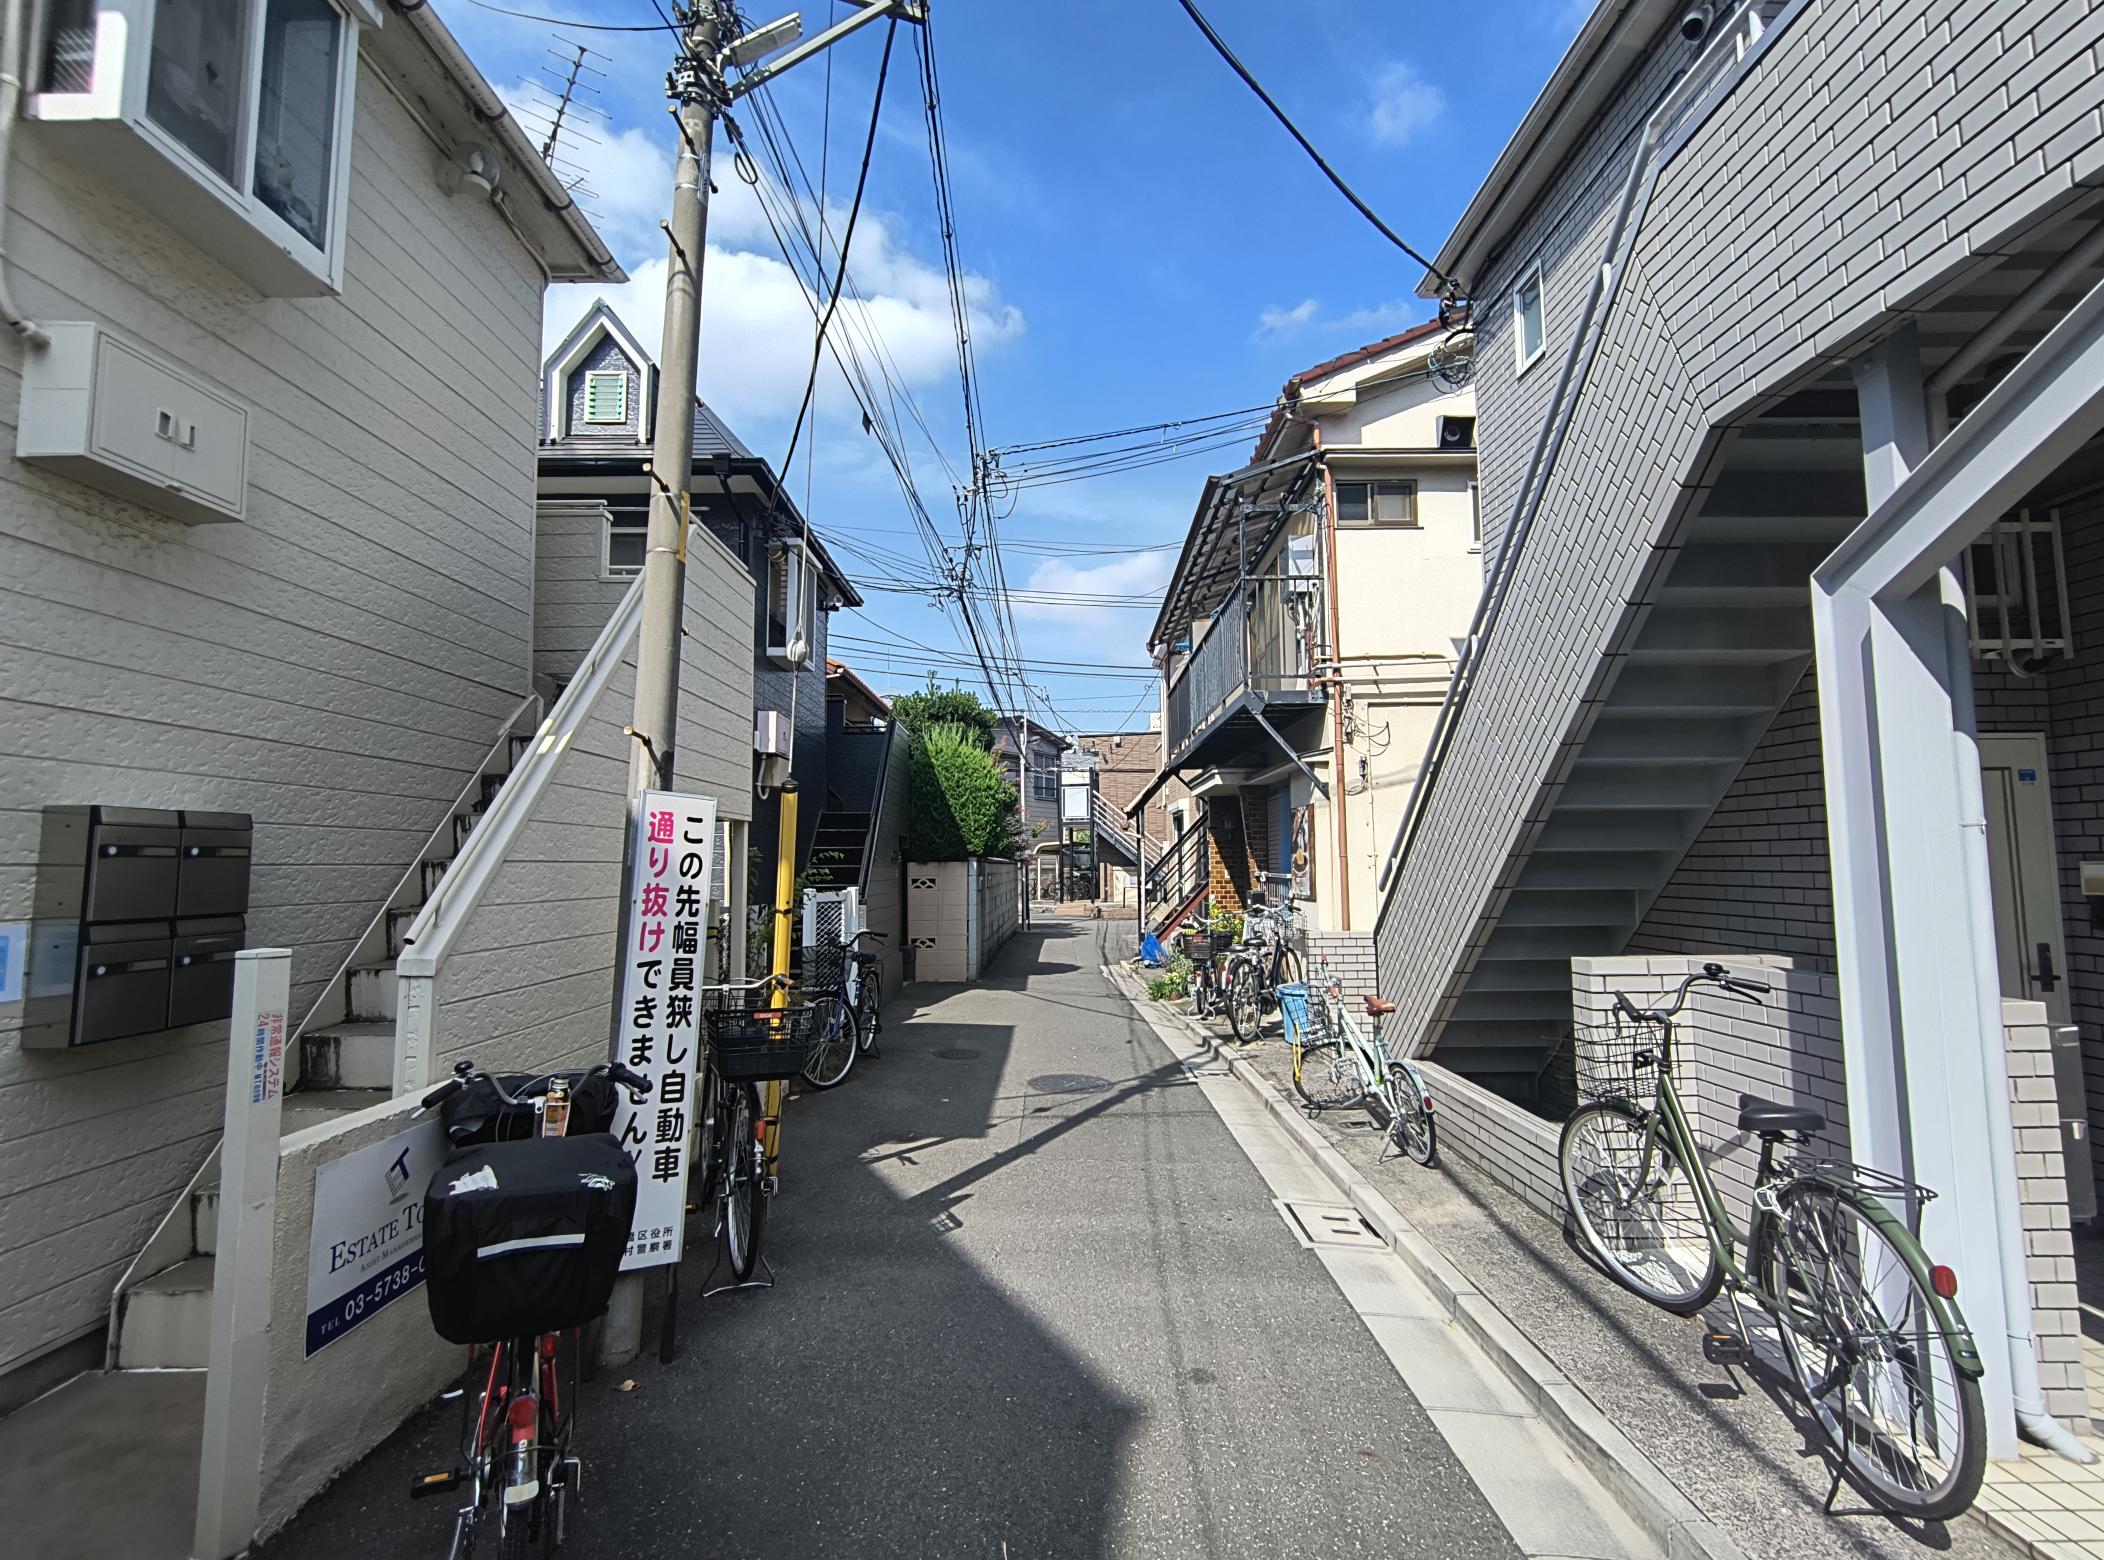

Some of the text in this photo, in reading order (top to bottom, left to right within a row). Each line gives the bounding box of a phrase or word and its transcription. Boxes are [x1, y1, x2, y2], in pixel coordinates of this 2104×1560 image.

[652, 816, 703, 1183] この先幅員狭し自動車
[268, 1013, 283, 1100] 非常通報システム
[329, 1219, 400, 1274] ESTATE
[321, 1317, 340, 1335] TEL
